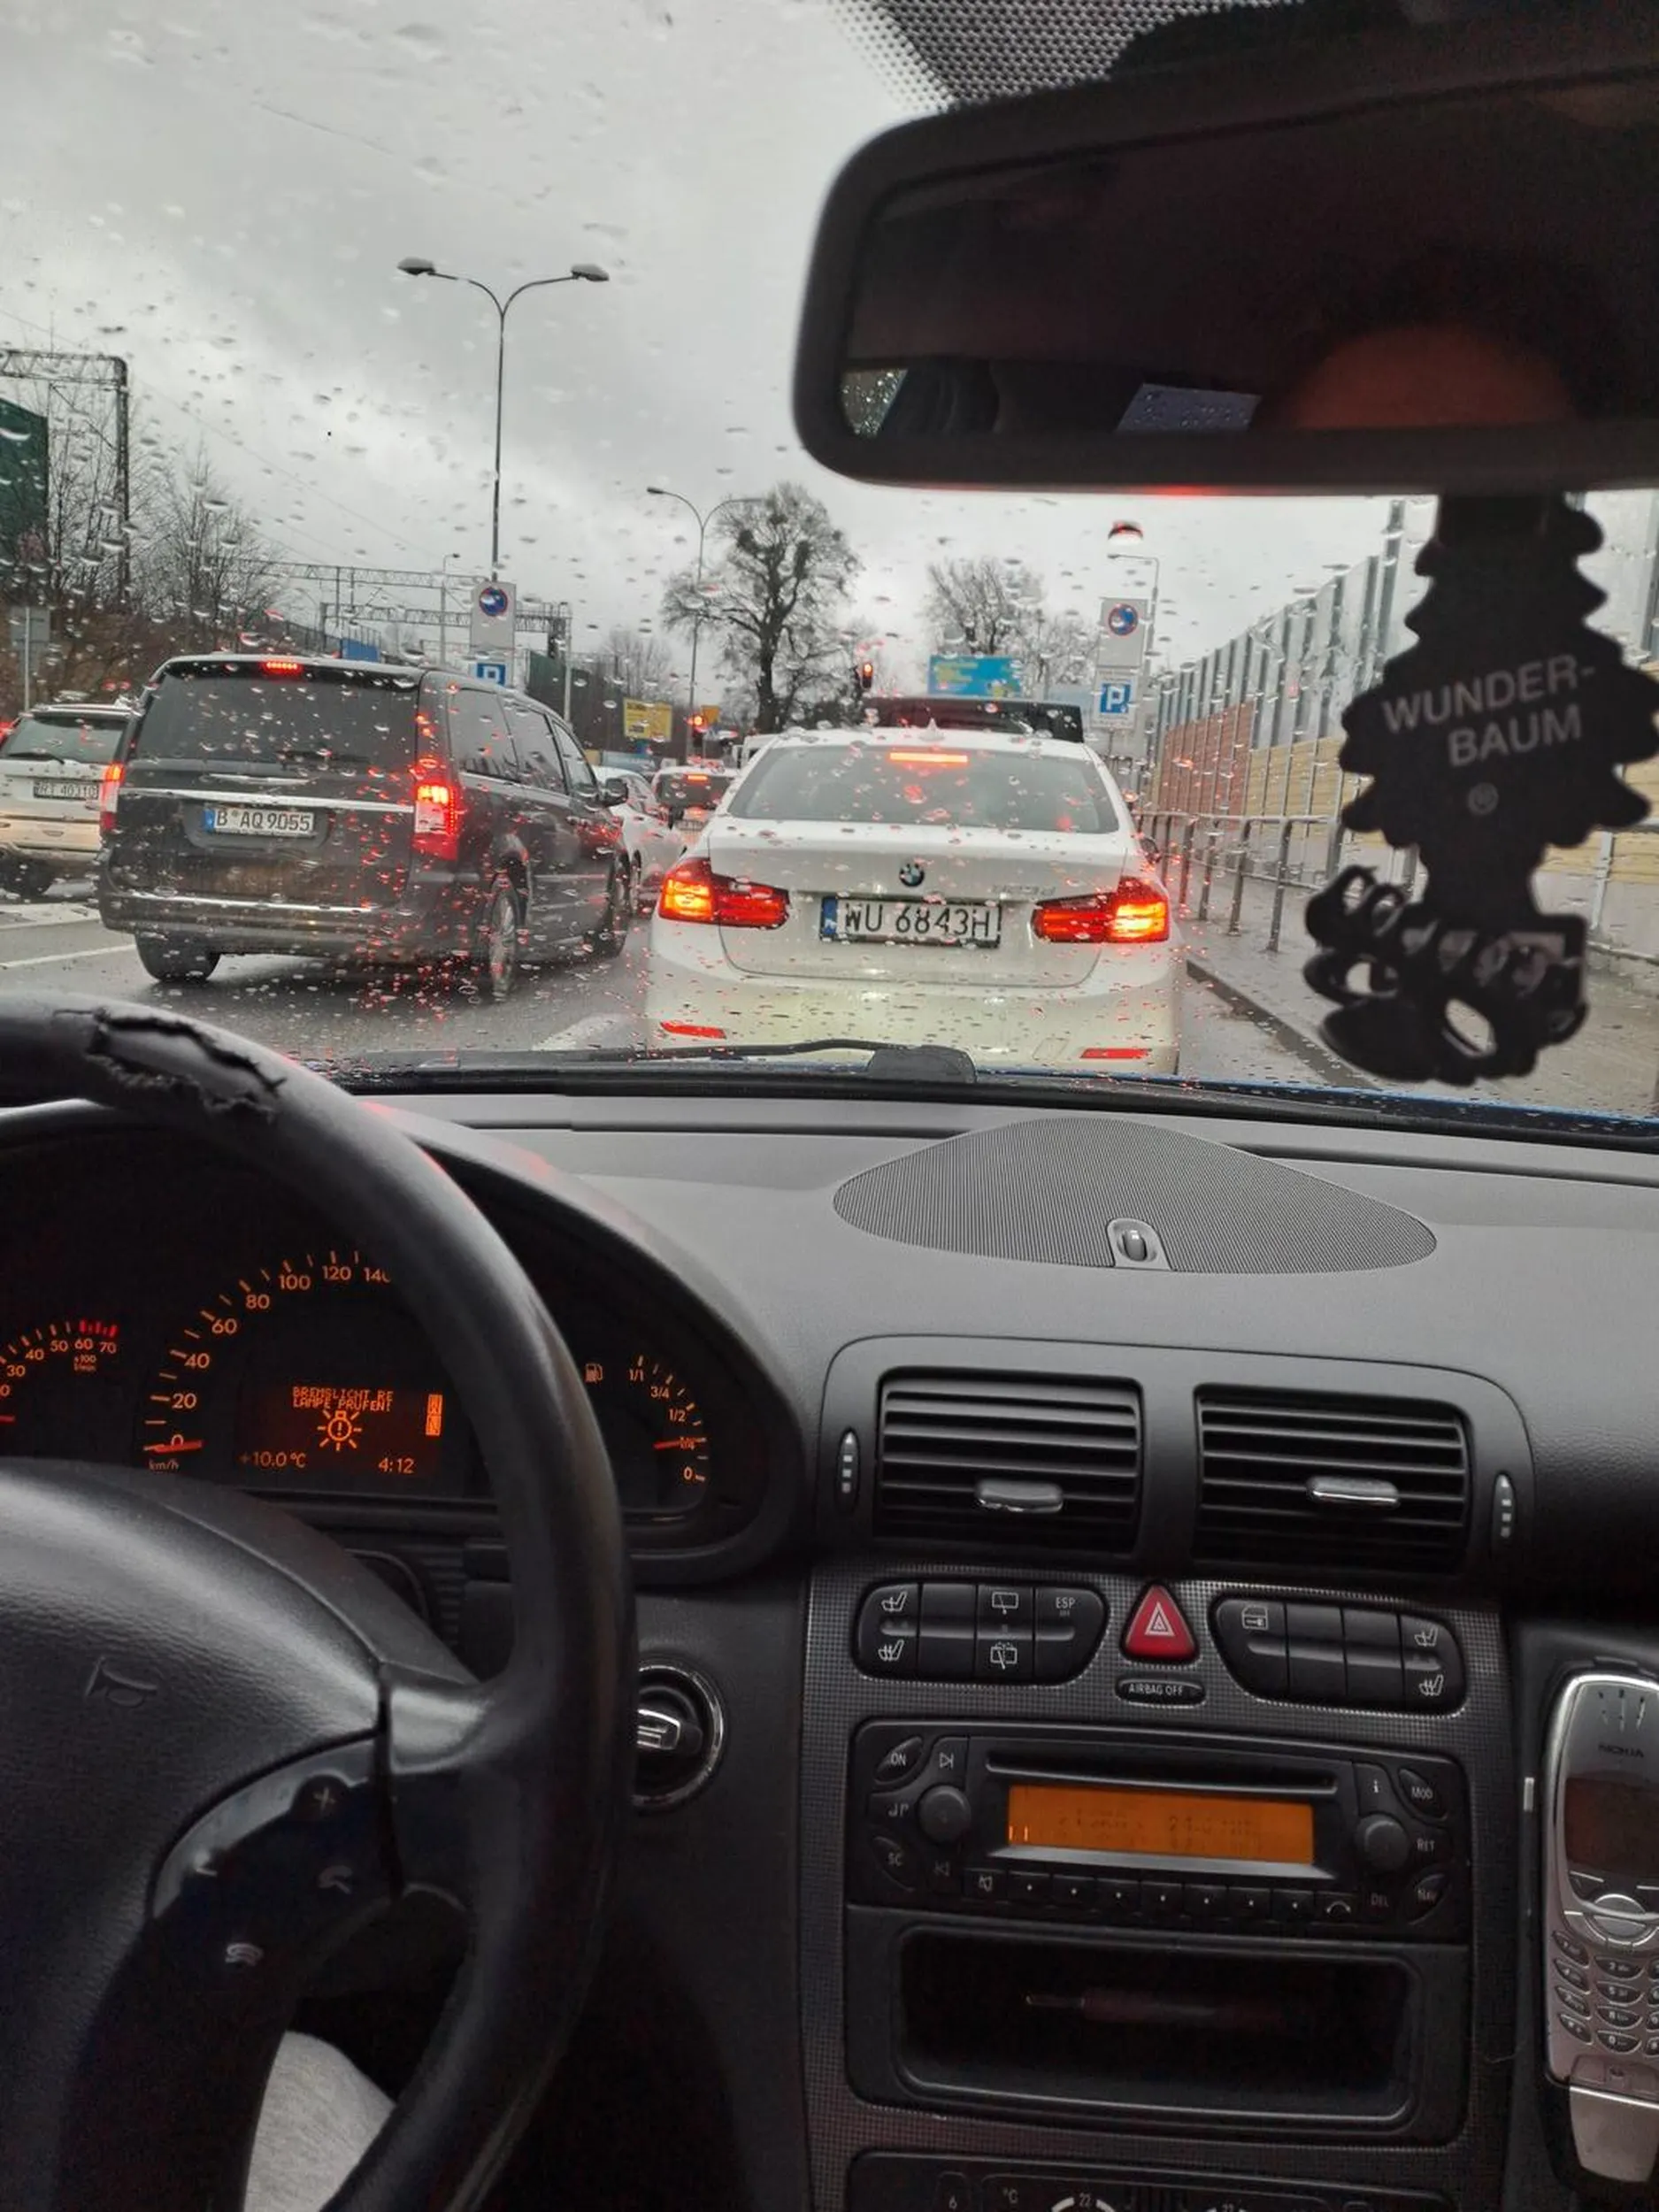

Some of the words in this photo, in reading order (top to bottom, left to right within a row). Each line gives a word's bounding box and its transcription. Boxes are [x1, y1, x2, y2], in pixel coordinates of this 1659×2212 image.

[1106, 686, 1126, 710] P
[1383, 653, 1595, 734] WUNDER-
[1448, 704, 1583, 768] BAUM
[217, 810, 228, 826] B
[845, 902, 883, 932] WU
[895, 904, 991, 938] 6843H
[321, 1265, 352, 1281] 120
[278, 1274, 311, 1290] 100
[245, 1294, 270, 1310] 80
[211, 1318, 237, 1334] 60
[50, 1340, 68, 1352] 50
[74, 1338, 94, 1350] 60
[99, 1341, 117, 1354] 70
[25, 1348, 44, 1361] 40
[184, 1353, 211, 1369] 40
[6, 1364, 26, 1377] 30
[650, 1386, 669, 1399] 3/4
[172, 1393, 197, 1409] 20
[669, 1409, 686, 1423] 1/2
[148, 1458, 180, 1471] km/h
[378, 1458, 415, 1474] 4:12
[683, 1466, 693, 1480] 0
[1056, 1596, 1076, 1609] ESP
[1128, 1683, 1163, 1695] AIRBAG
[1165, 1685, 1183, 1696] OFF
[890, 1753, 907, 1766] ON
